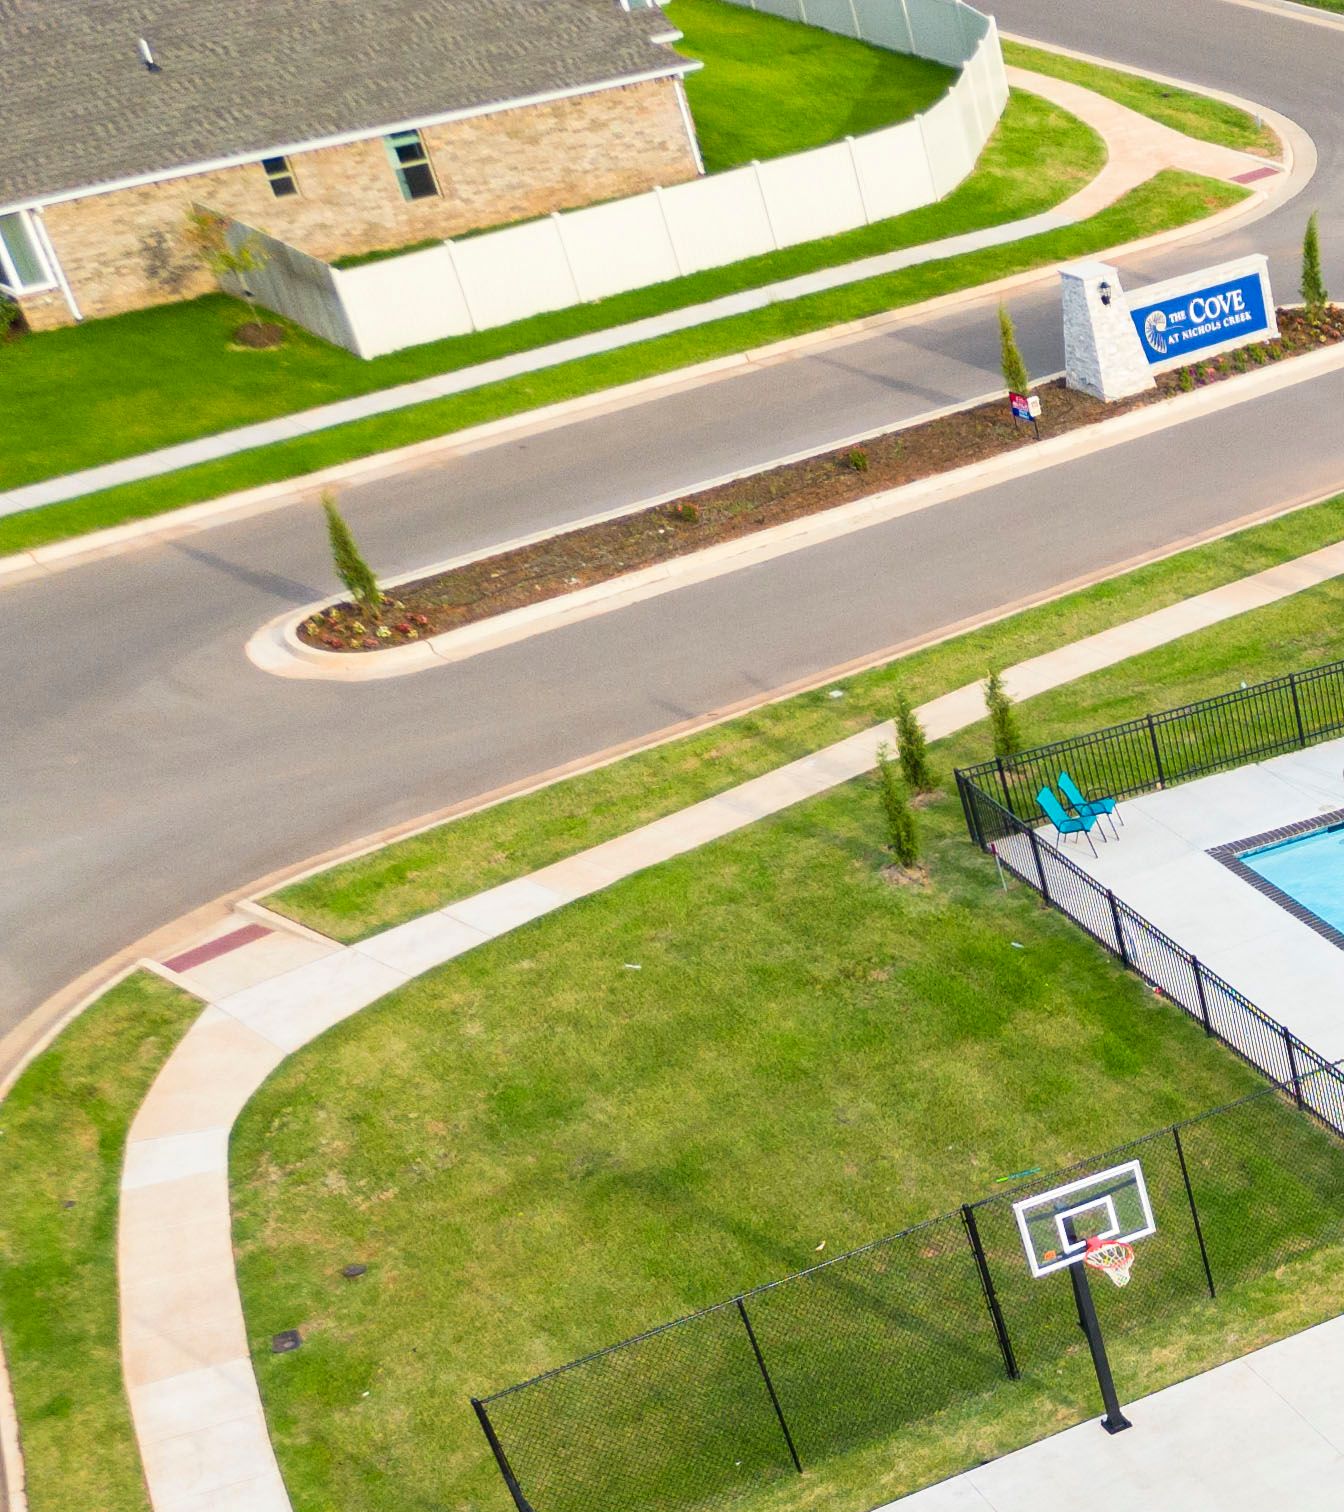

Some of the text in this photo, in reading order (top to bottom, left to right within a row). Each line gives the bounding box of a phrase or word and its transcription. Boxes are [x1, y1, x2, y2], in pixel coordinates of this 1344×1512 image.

[1168, 289, 1245, 323] THE COVE
[1168, 311, 1252, 345] AT NICHOLS CREEK
